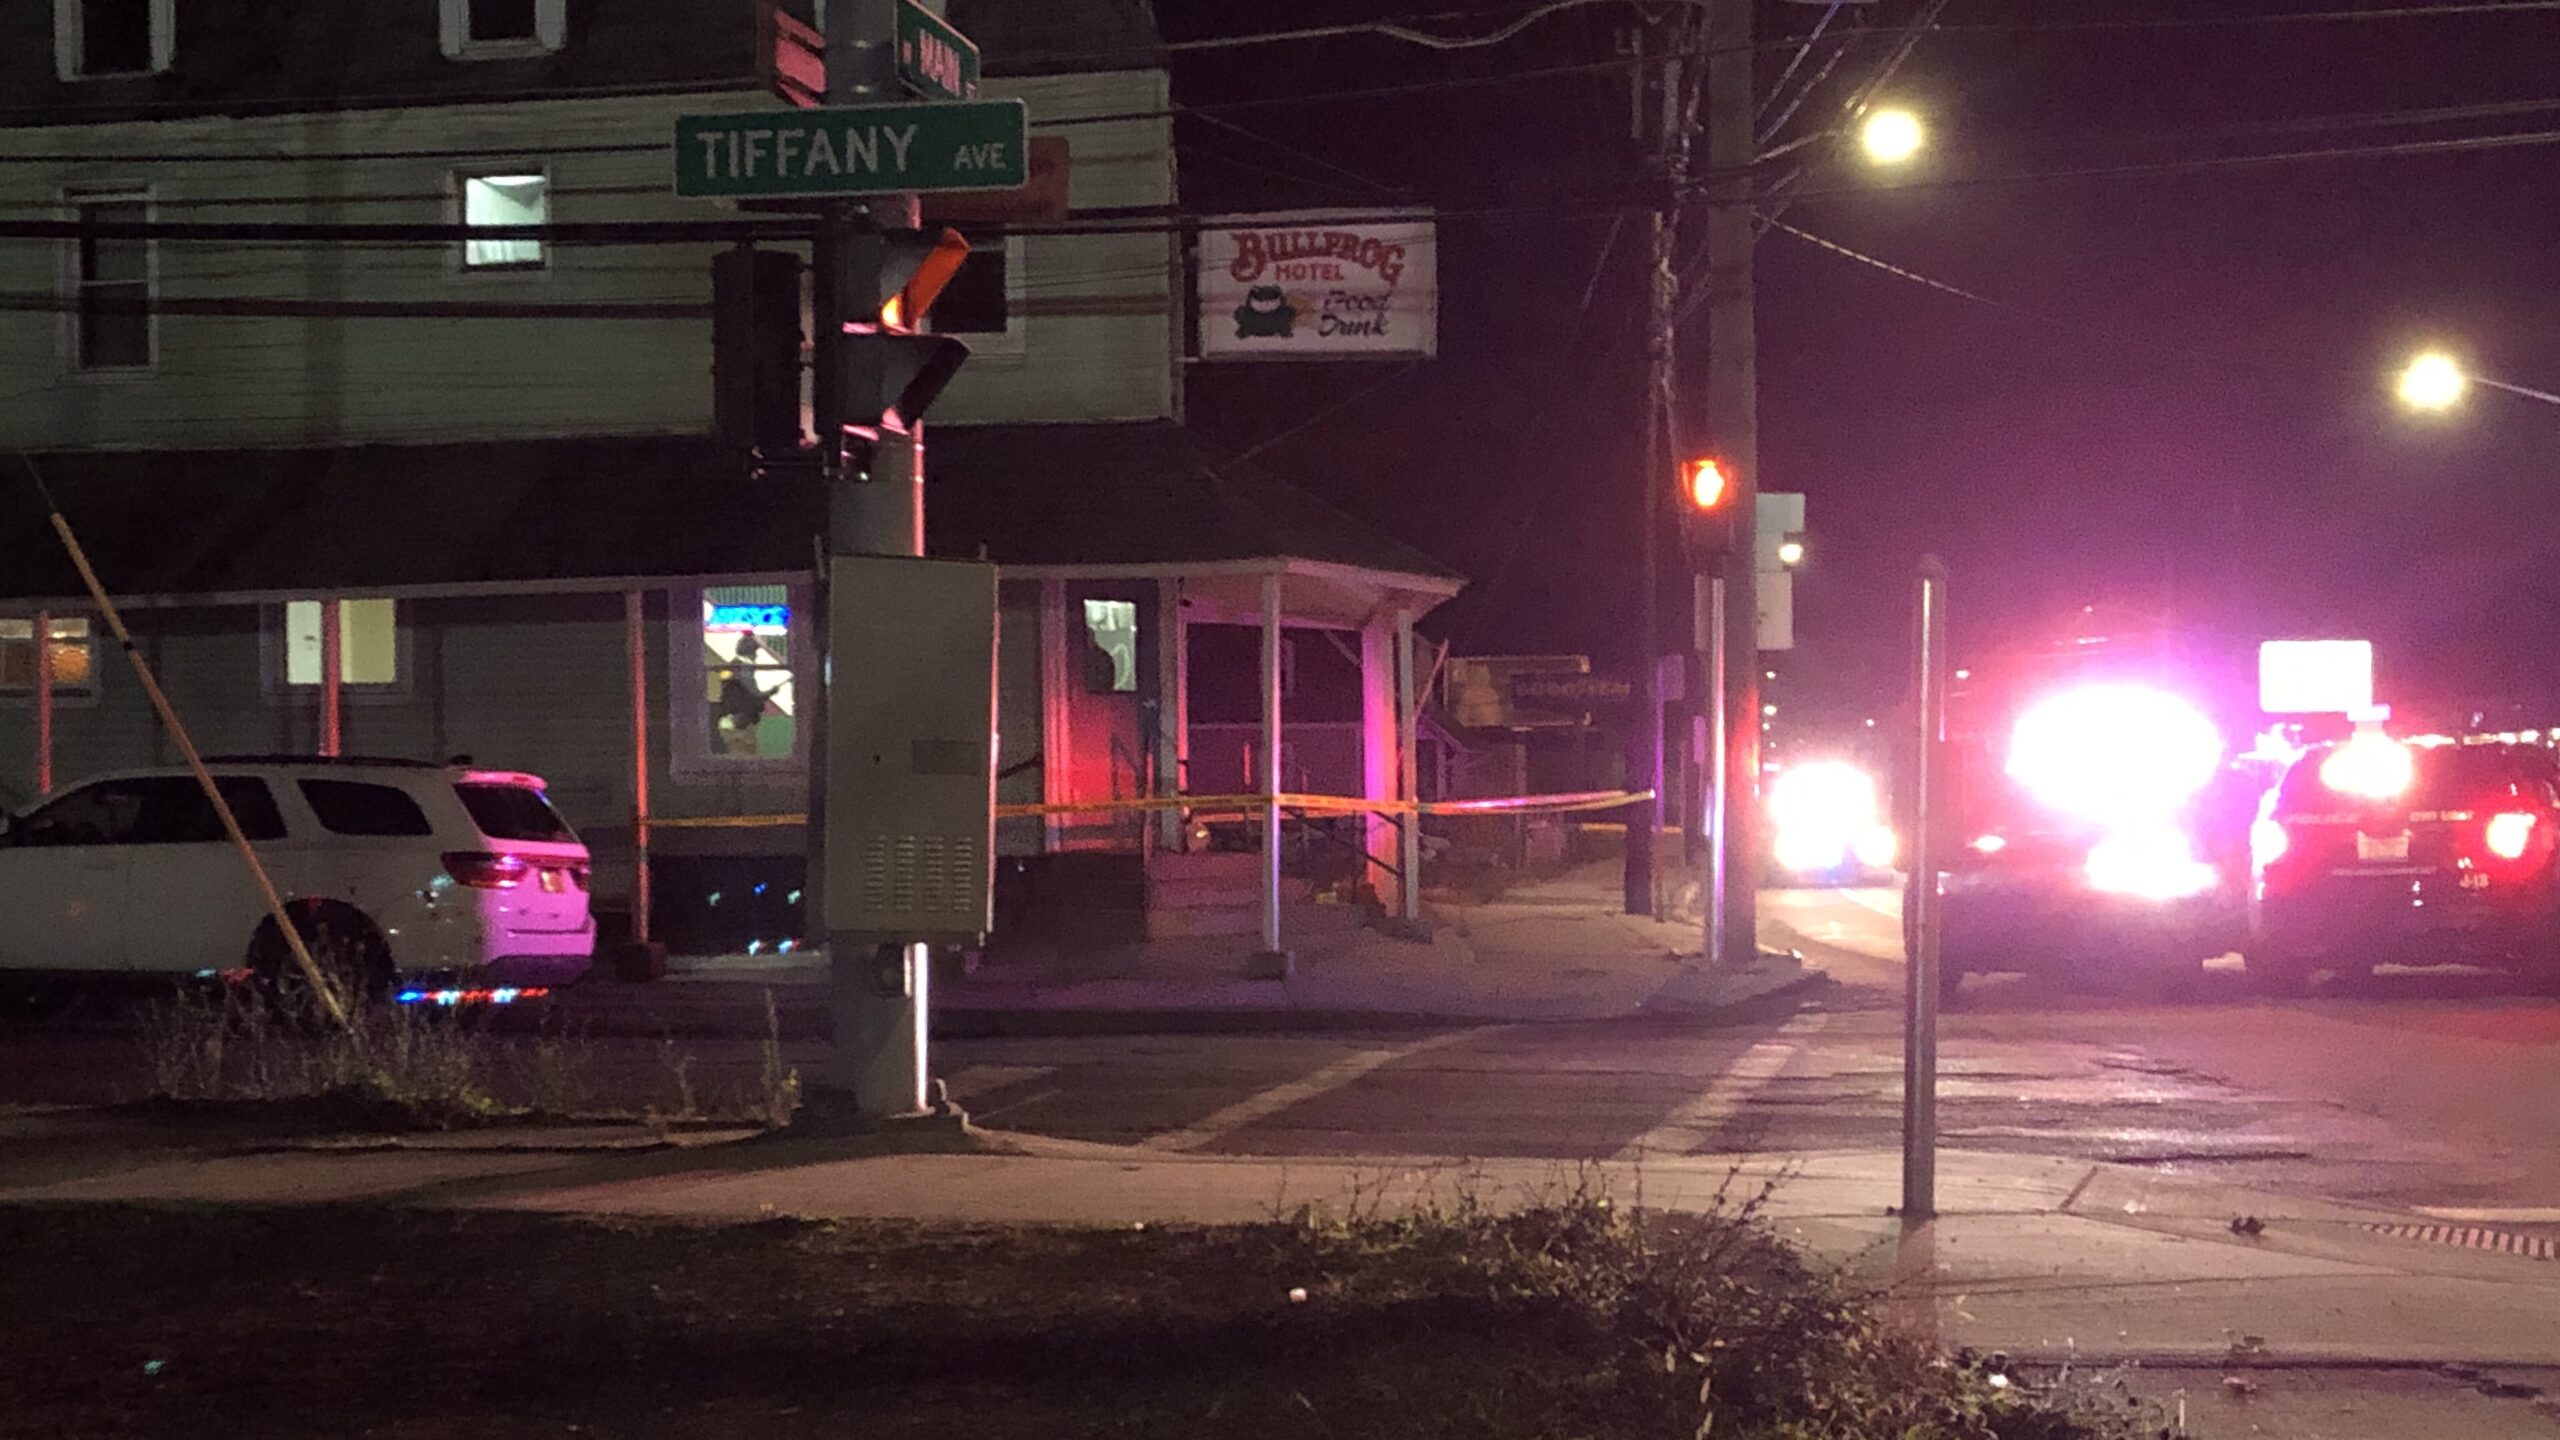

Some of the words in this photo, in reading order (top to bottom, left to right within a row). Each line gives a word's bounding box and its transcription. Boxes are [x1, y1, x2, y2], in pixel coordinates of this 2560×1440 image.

[696, 125, 918, 178] TIFFANY
[954, 142, 1007, 171] AVE
[1230, 231, 1406, 285] BULLFROG
